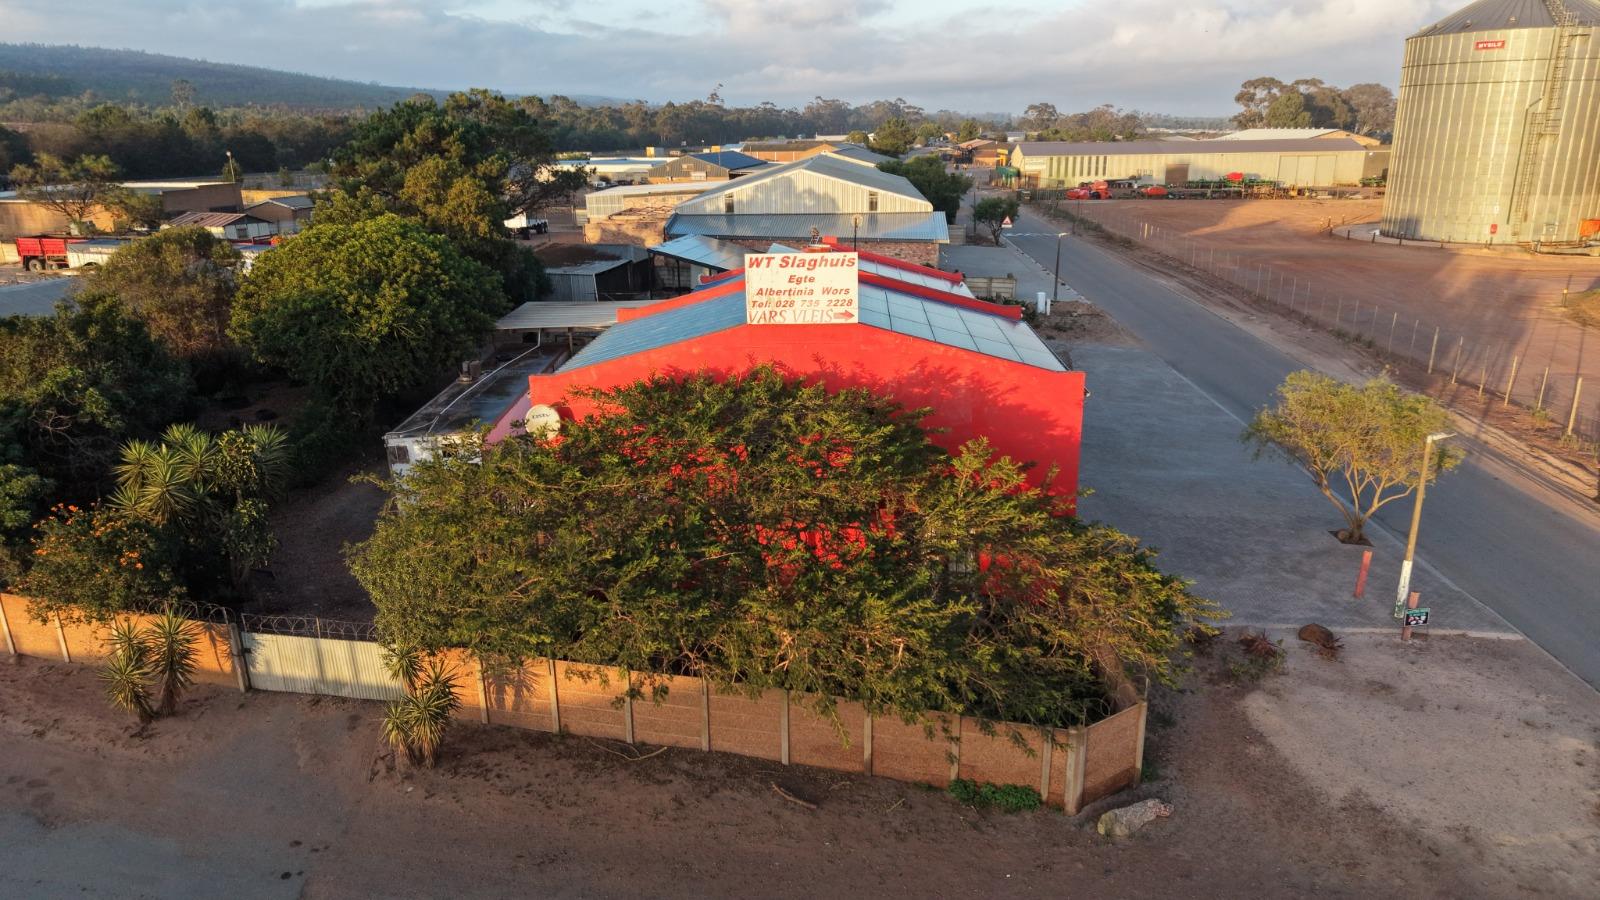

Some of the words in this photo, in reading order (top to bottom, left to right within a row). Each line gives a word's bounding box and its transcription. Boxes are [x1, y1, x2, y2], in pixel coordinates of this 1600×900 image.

[748, 256, 775, 269] WT
[779, 255, 856, 270] Slaghuis
[788, 275, 816, 285] Egte
[756, 287, 814, 297] Albertinia
[821, 287, 850, 295] Wors
[775, 300, 795, 308] 028
[826, 299, 853, 307] 2228
[748, 310, 787, 324] VARS
[792, 309, 833, 323] VLEIS
